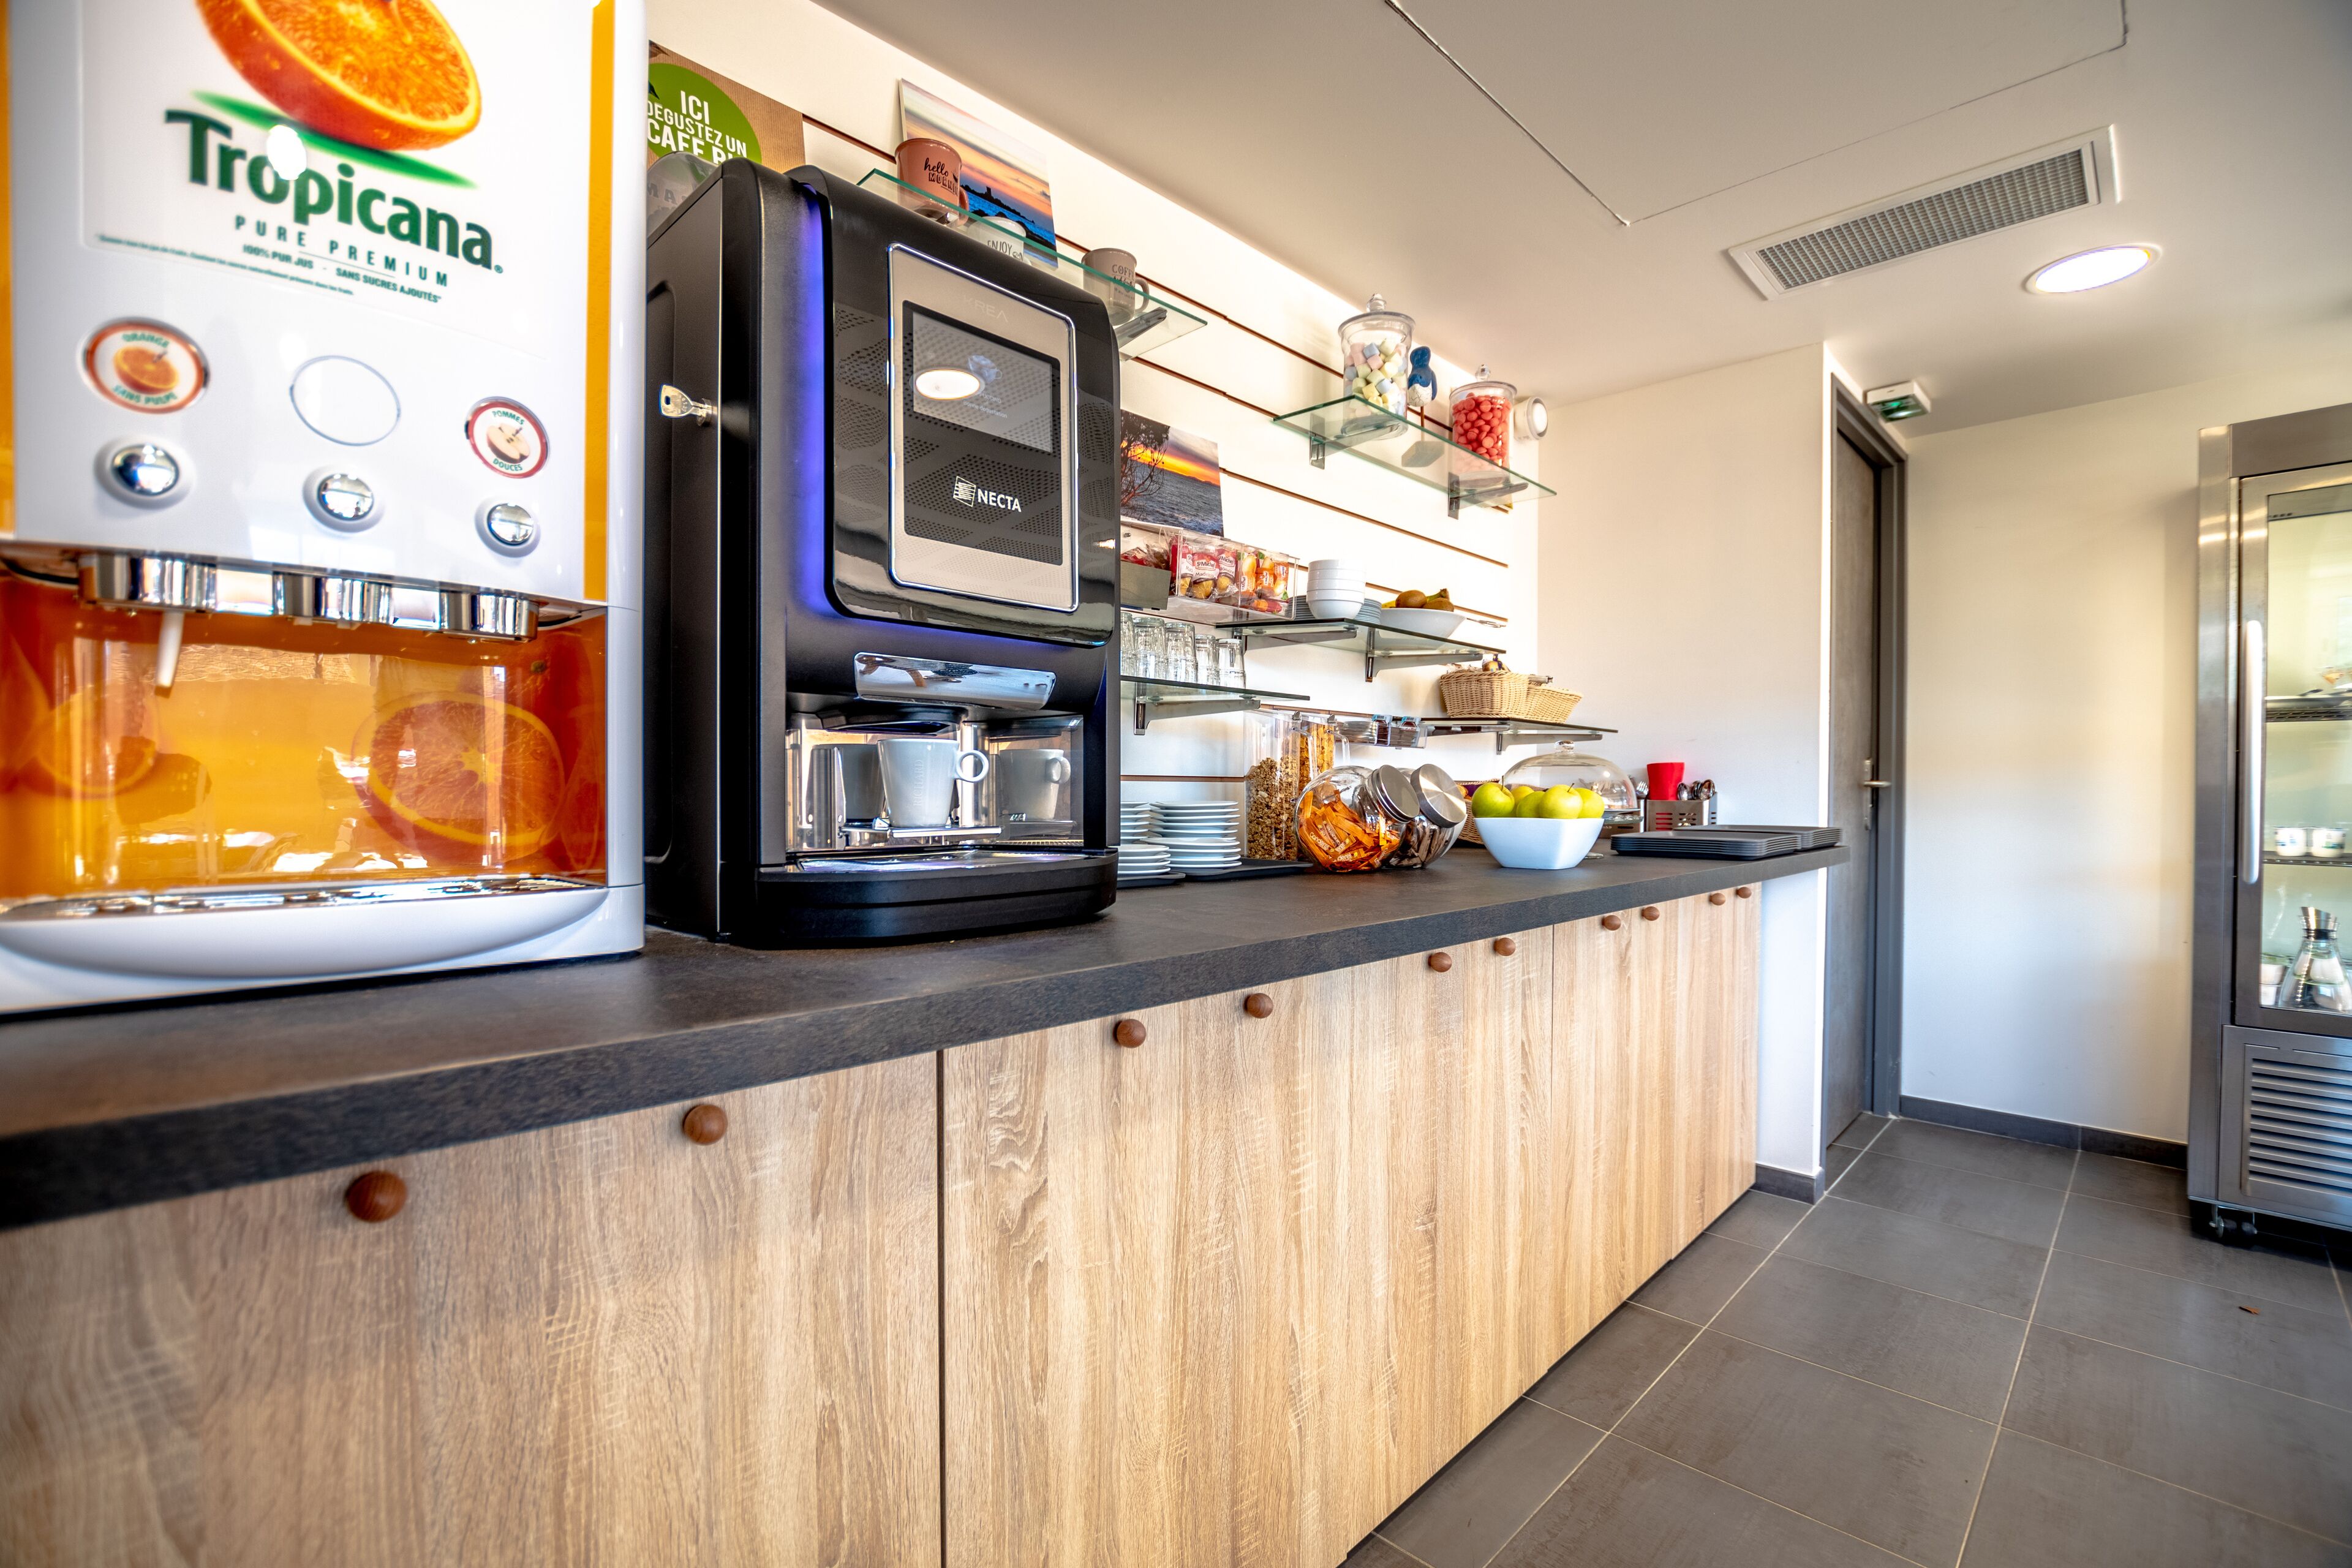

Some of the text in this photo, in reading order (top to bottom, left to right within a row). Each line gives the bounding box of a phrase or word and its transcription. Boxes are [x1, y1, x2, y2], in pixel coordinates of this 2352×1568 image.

[680, 90, 710, 125] ICI
[726, 135, 747, 157] UN
[924, 157, 949, 177] hello
[165, 109, 493, 270] Tropicana
[235, 214, 448, 287] PURE PREMIUM
[987, 239, 1012, 256] ENJOY
[243, 244, 270, 258] 100%
[271, 251, 292, 263] PUR
[294, 257, 314, 269] JUS
[336, 267, 361, 282] SANS
[363, 272, 398, 292] SUCRES
[492, 410, 525, 425] POMMES
[492, 458, 523, 472] DOUCES
[977, 488, 1022, 513] NECTA
[913, 760, 924, 807] RICHARD
[1310, 832, 1330, 851] Canderel
